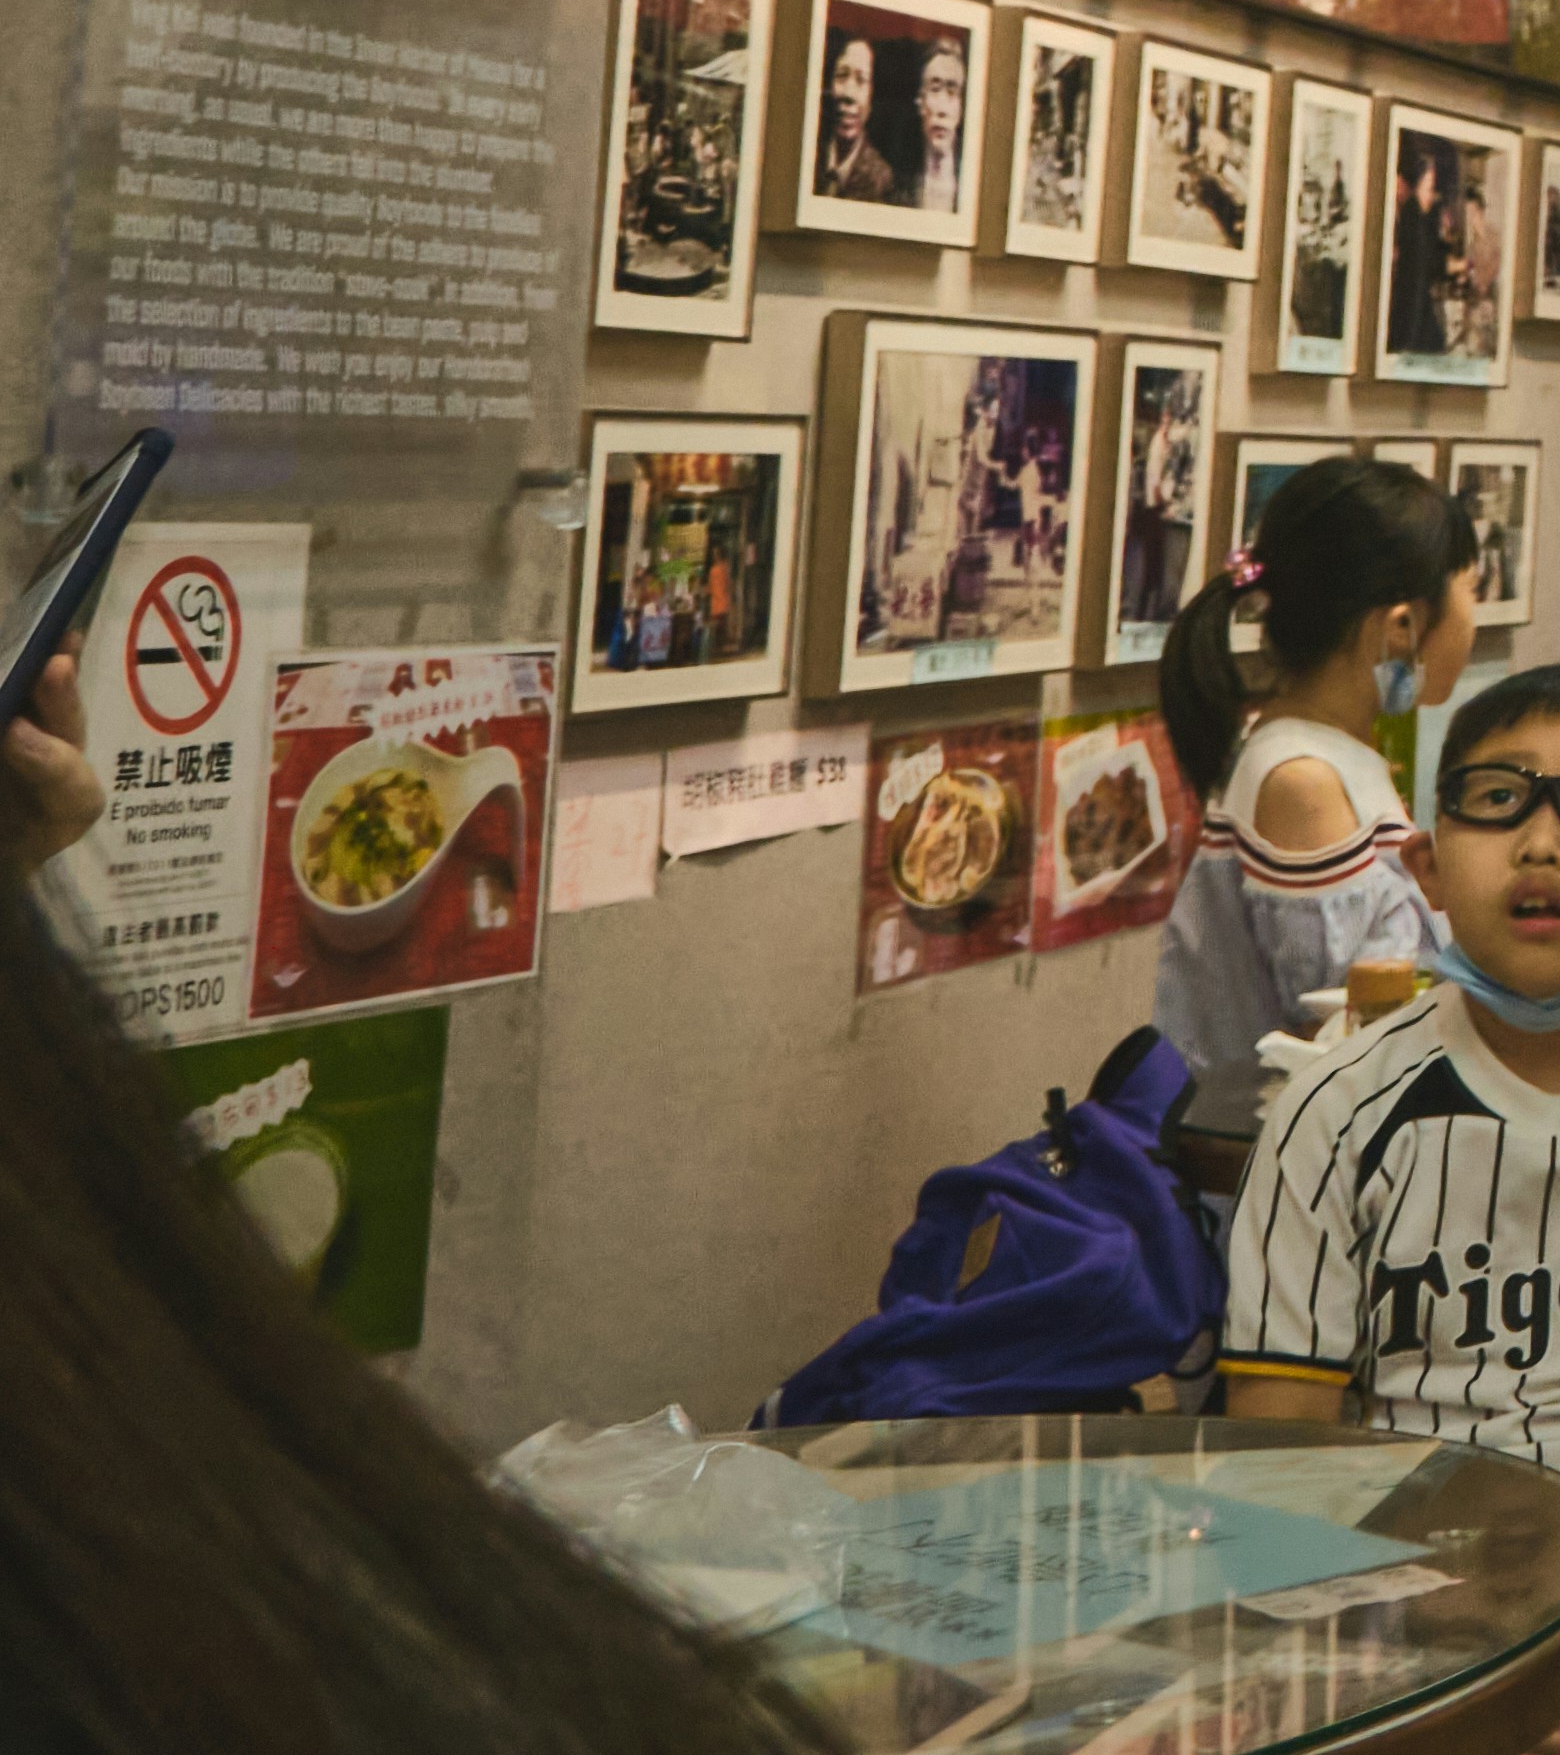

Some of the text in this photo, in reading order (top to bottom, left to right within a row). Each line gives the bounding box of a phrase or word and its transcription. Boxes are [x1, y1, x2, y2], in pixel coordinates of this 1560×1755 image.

[114, 741, 234, 793] 禁止吸煙
[124, 799, 184, 823] proibido
[186, 795, 231, 813] fumar
[126, 821, 213, 846] No smoking
